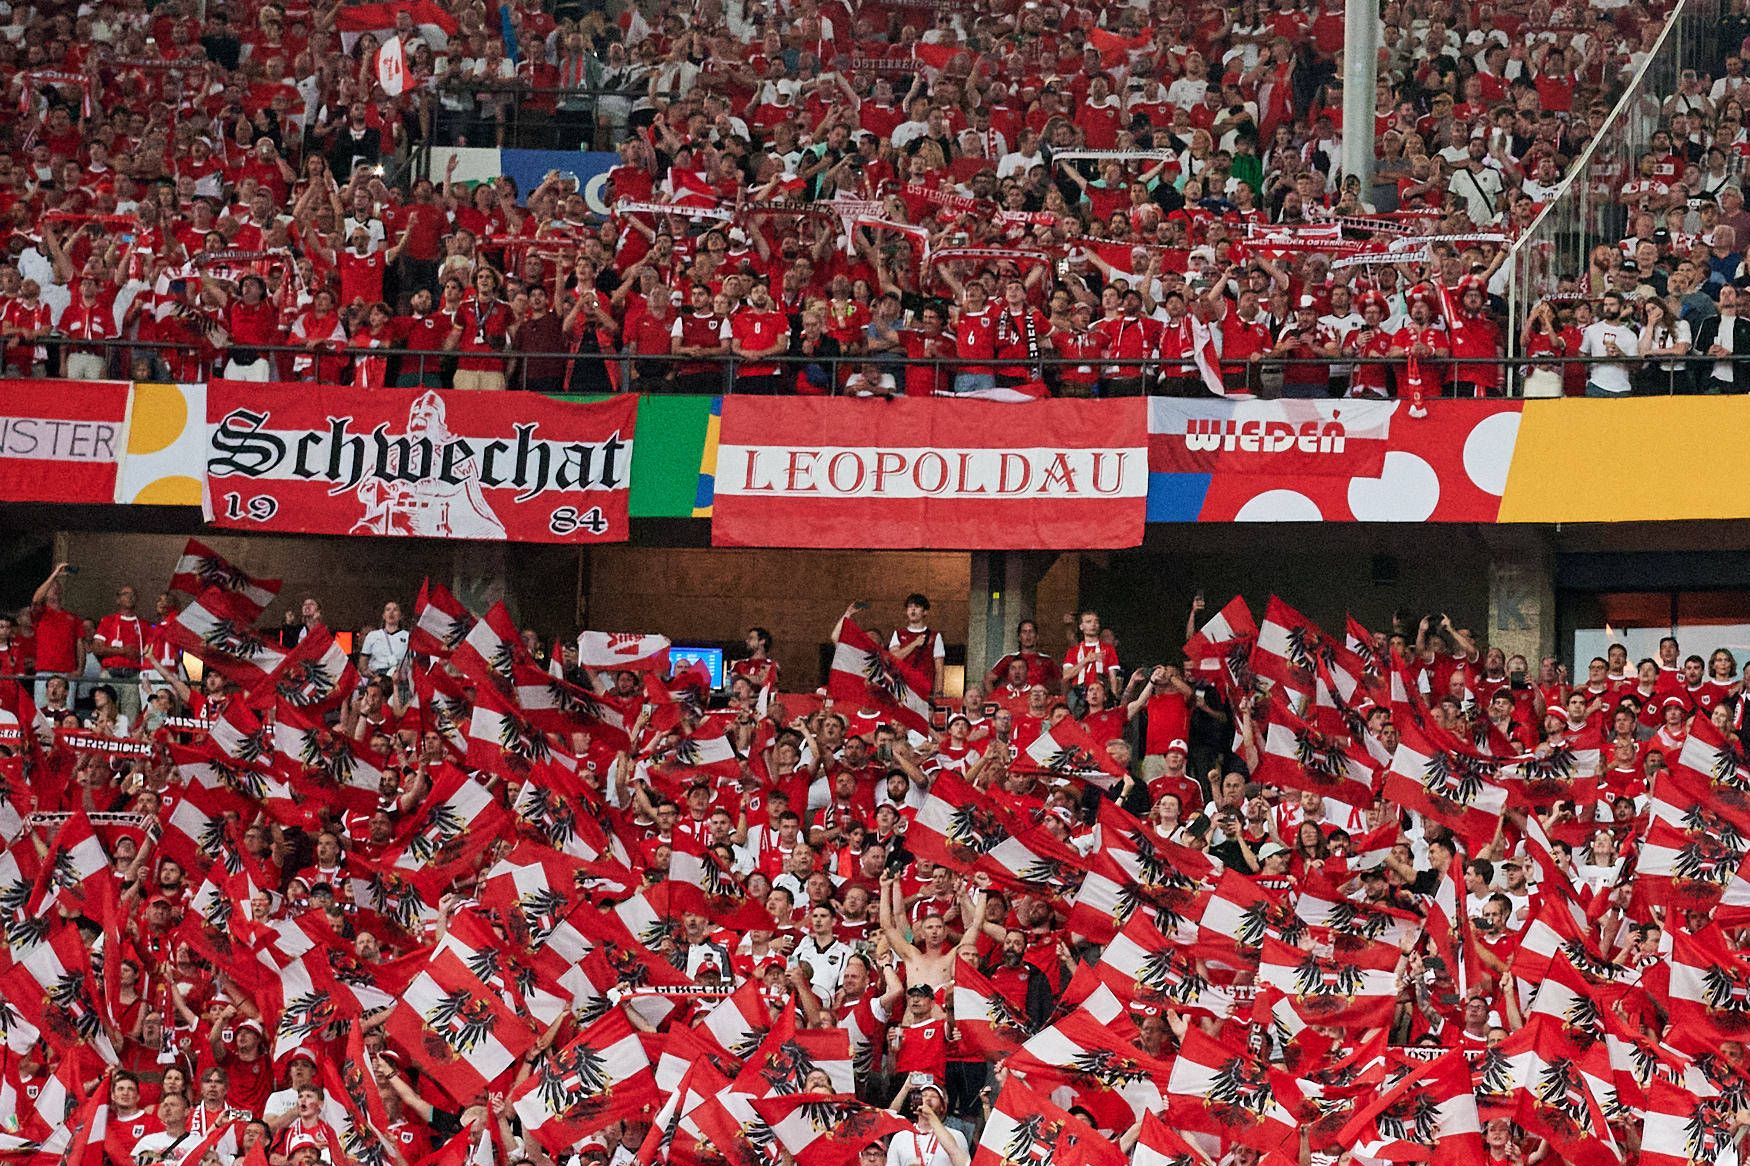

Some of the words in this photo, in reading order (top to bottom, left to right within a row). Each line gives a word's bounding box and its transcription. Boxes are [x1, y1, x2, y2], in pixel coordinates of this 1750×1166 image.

[967, 330, 975, 345] 6
[208, 406, 626, 503] Schwechat
[742, 447, 1128, 497] LEOPOLDAU
[224, 491, 279, 522] 19
[548, 505, 608, 536] 84
